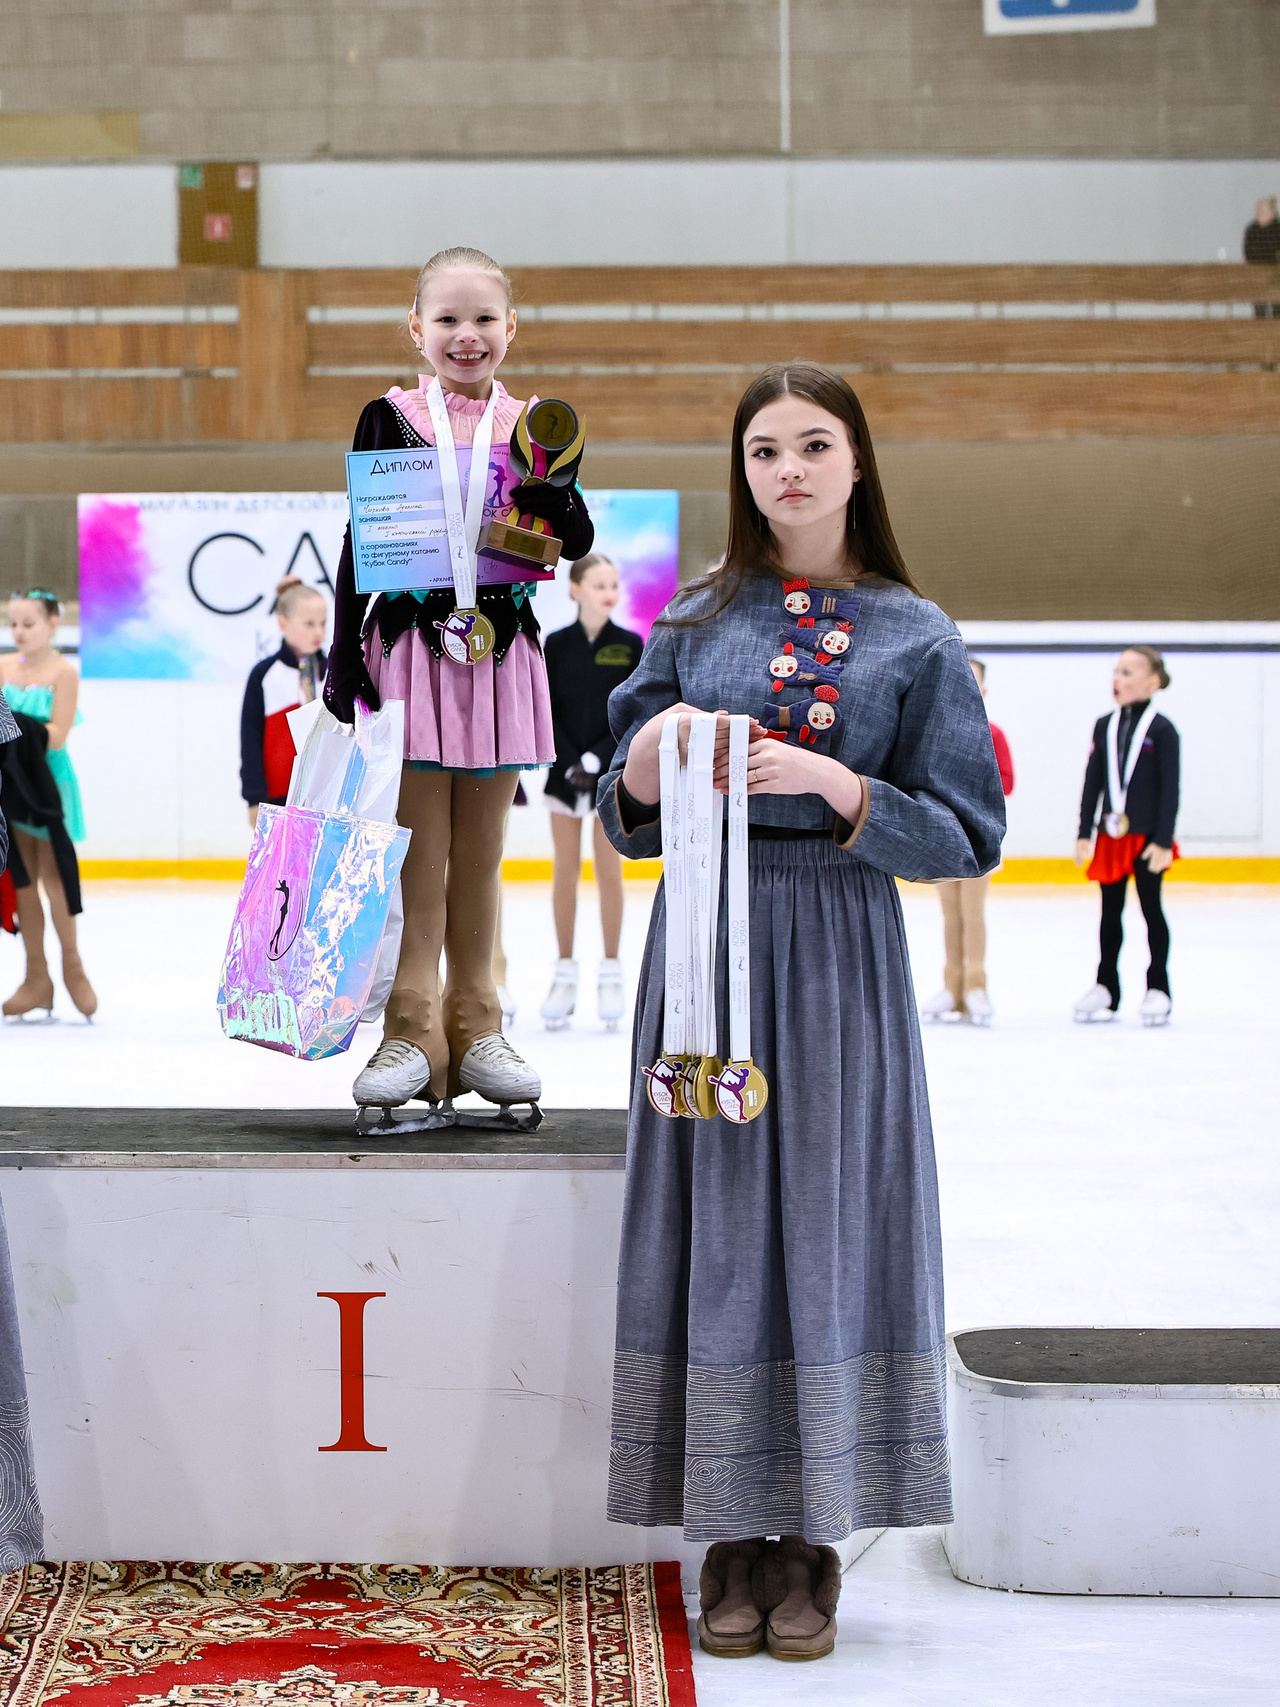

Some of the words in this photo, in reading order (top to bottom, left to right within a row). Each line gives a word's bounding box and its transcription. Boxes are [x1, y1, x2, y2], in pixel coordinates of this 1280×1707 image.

[370, 459, 433, 476] Диплом
[356, 493, 407, 503] Награждается
[358, 515, 392, 523] занявшая
[366, 541, 418, 551] соревнованиях
[370, 549, 410, 559] фигурному
[472, 635, 480, 650] 1
[739, 920, 747, 947] КУБОК
[745, 1090, 753, 1106] 1
[317, 1291, 387, 1453] I
